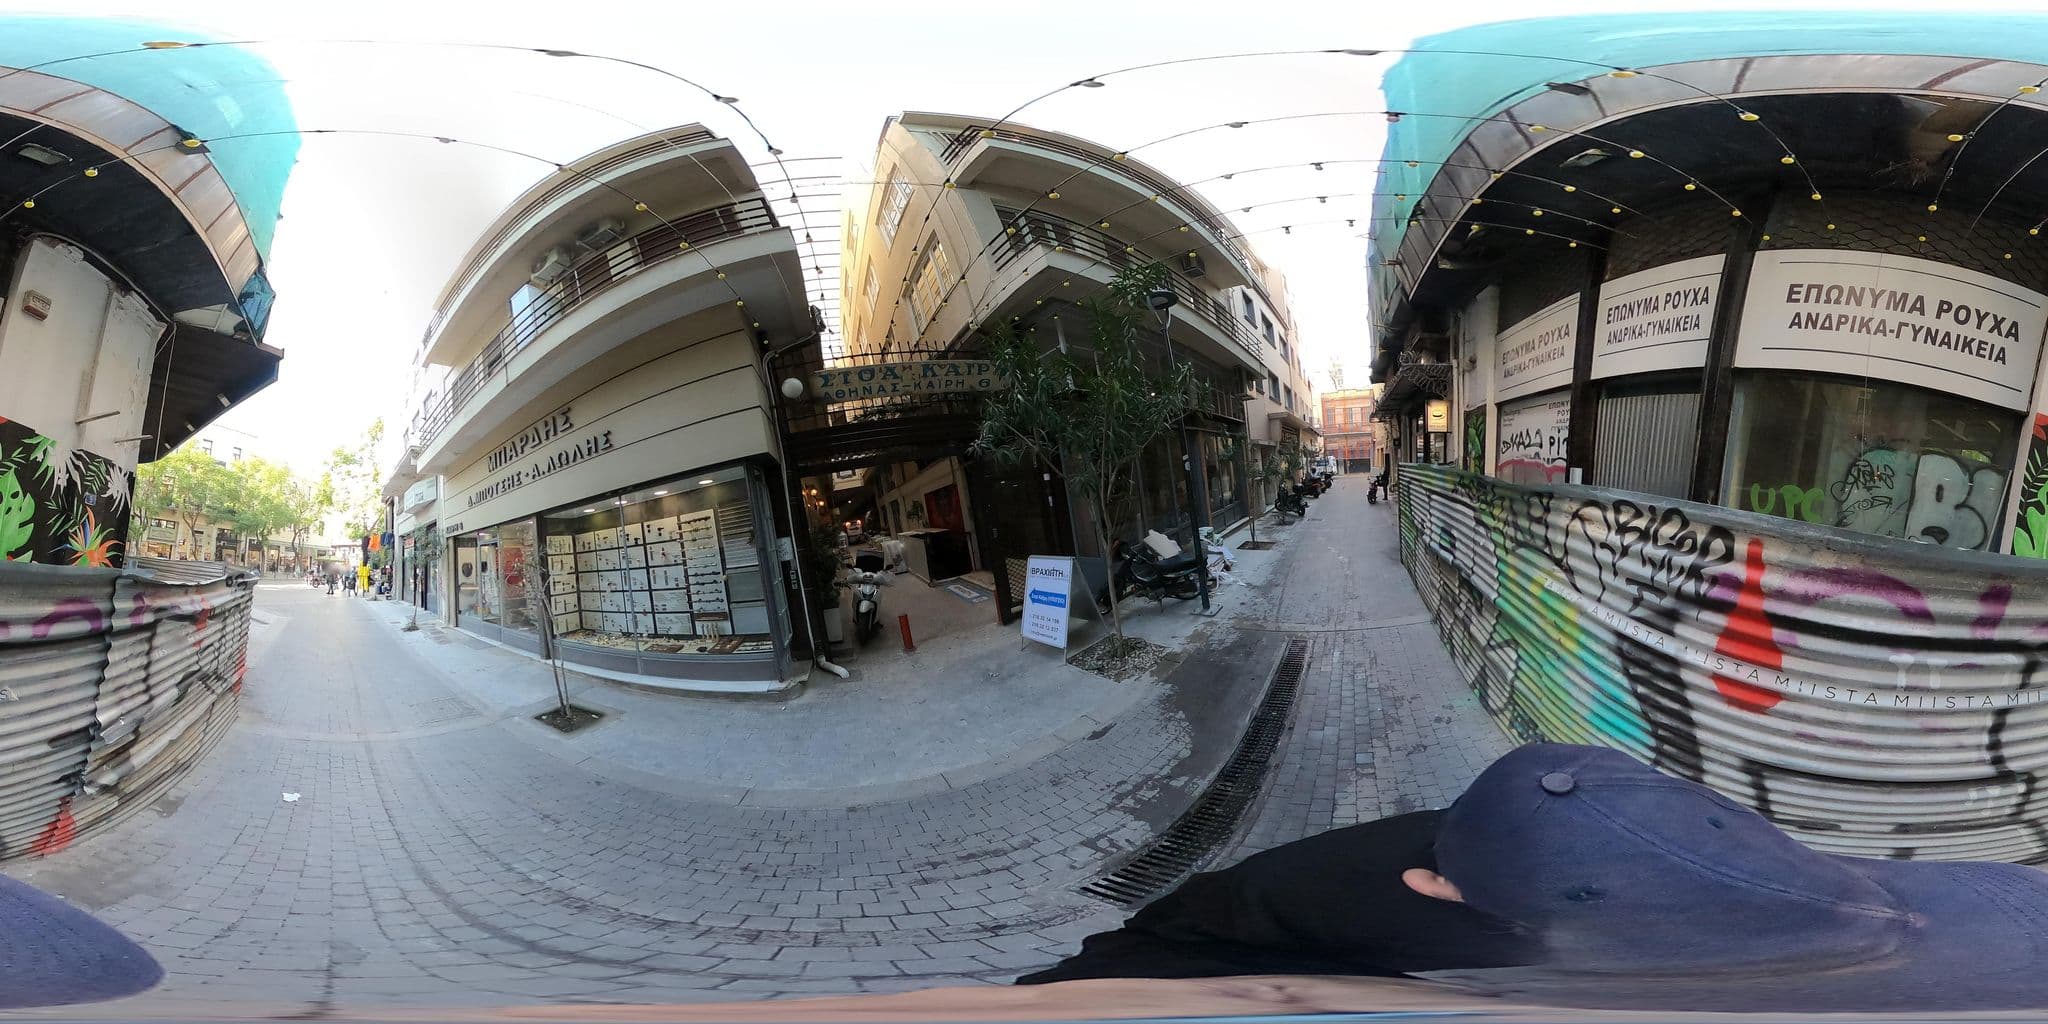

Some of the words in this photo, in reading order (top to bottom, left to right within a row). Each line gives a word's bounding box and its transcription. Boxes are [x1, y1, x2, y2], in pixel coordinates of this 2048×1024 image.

[1606, 297, 1659, 325] ΕΠΩΝΥΜΑ
[1663, 286, 1710, 312] ΡΟΥΧΑ
[1785, 283, 1926, 316] ΕΠΩΝΥΜΑ
[1935, 299, 2020, 342] ΡΟΥΧΑ
[1502, 339, 1536, 366] ΕΠΩΝΥΜΑ
[1537, 323, 1571, 350] ΡΟΥΧΑ
[1606, 314, 1700, 346] ΑΝΔΡΙΚΑ-ΓΥΝΑΙΚΕΙΑ
[1788, 311, 2007, 365] ΑΝΔΡΙΚΑ-ΓΥΝΑΙΚΕΙΑ
[1503, 345, 1565, 379] ΑΝΔΡΙΚΑ-ΓΥΝΑΙΚΕΙΑ
[487, 406, 575, 474] ΜΠΑΡΔΗΣ
[1606, 612, 1665, 649] MIISTA
[1775, 675, 1879, 705] MIISTA
[1894, 695, 1994, 709] MIISTA
